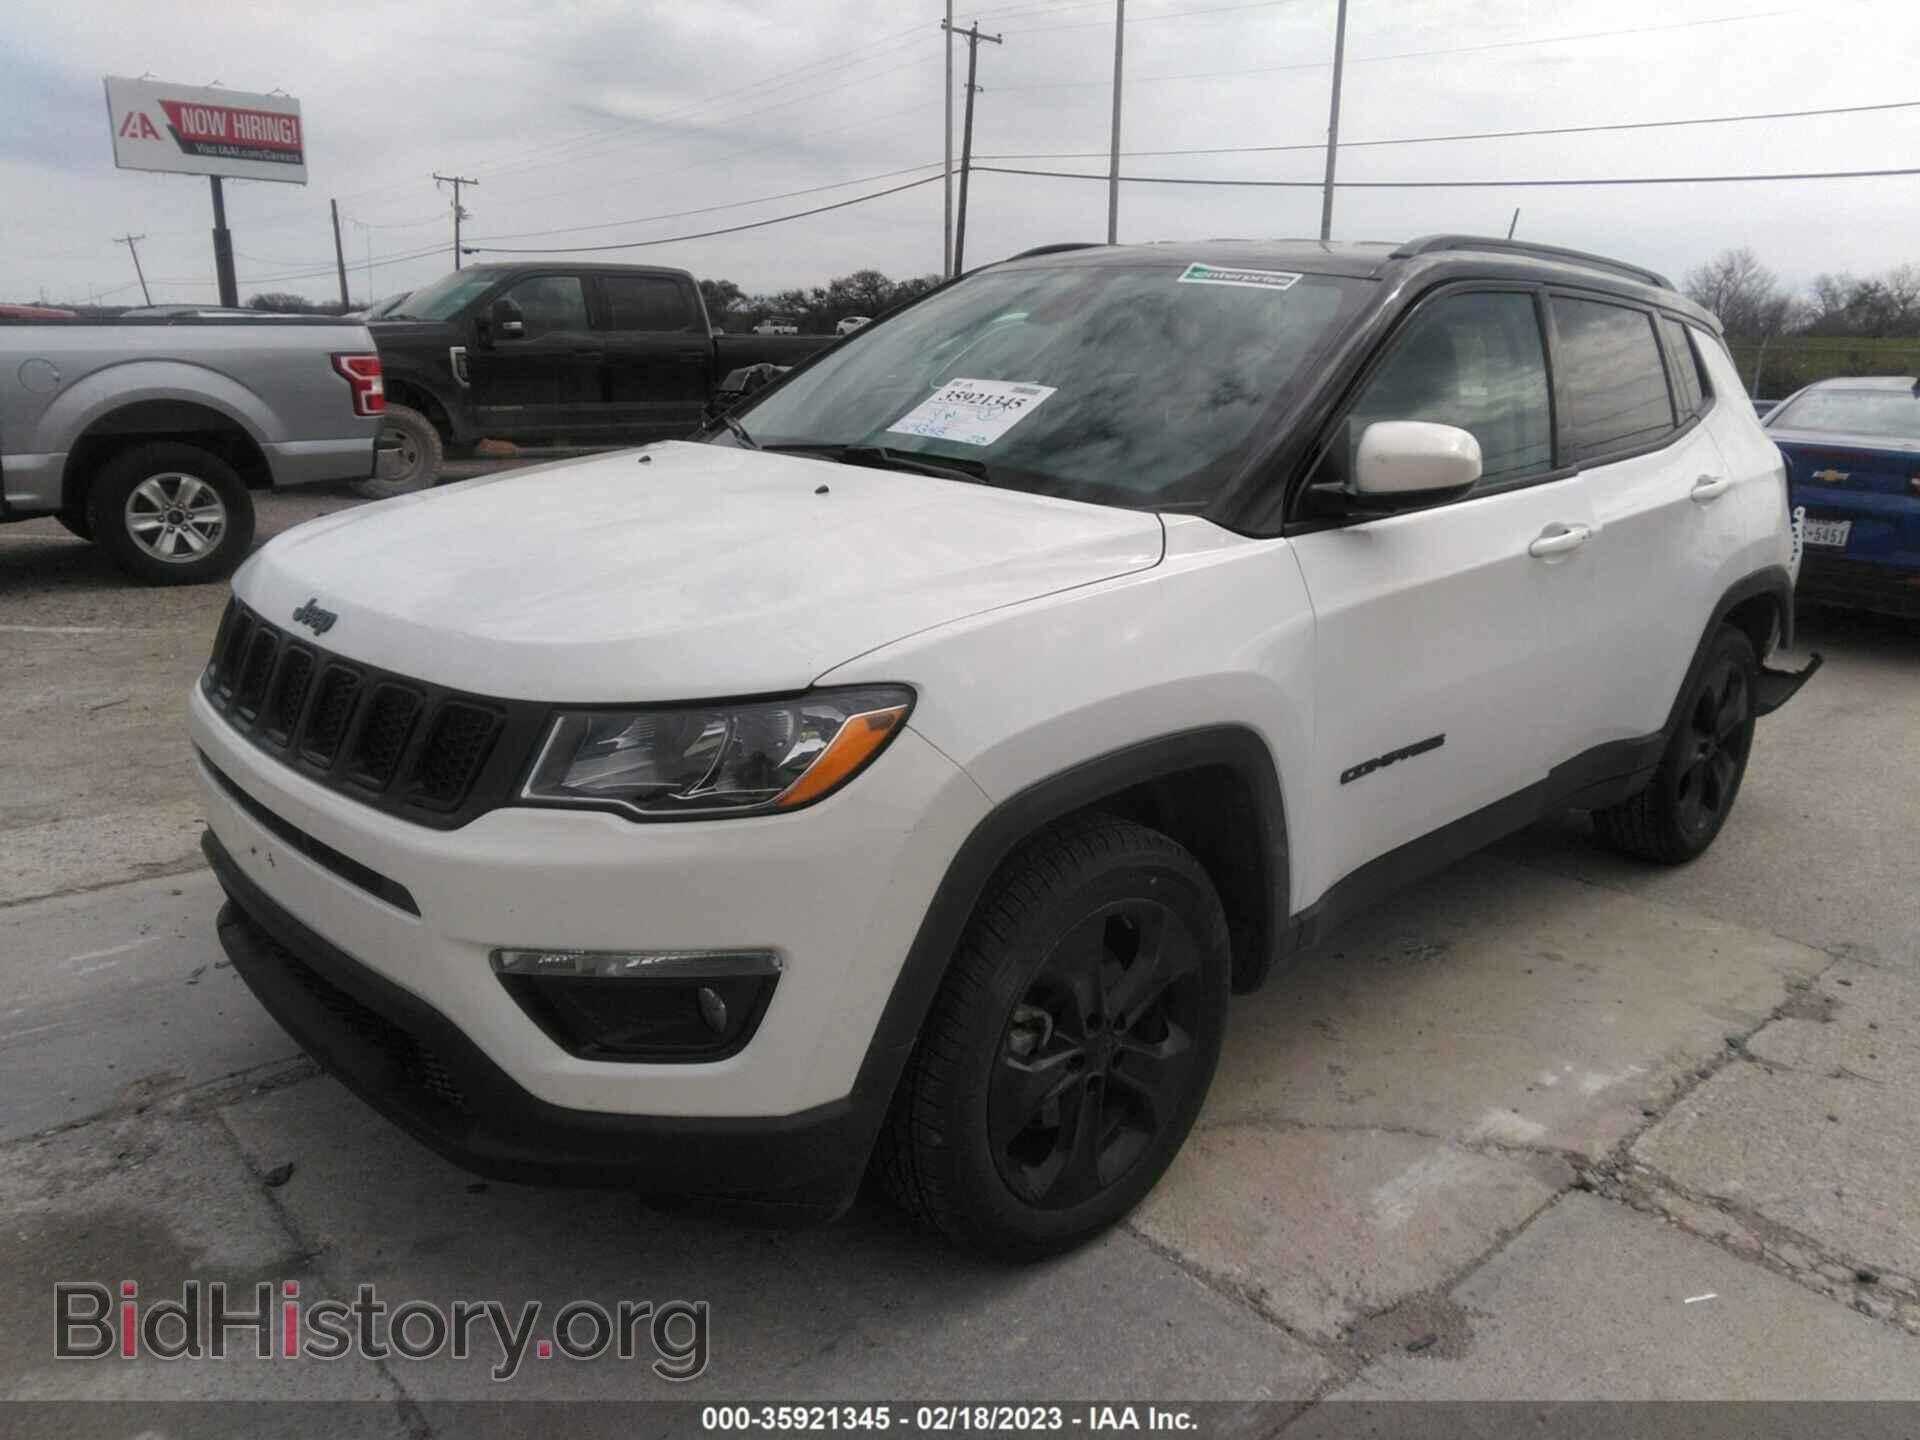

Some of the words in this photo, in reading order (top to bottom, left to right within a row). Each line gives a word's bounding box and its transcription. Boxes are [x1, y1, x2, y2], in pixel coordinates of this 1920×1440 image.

[180, 106, 227, 137] NOW
[232, 113, 298, 145] HIRING!
[292, 597, 338, 637] Jeep
